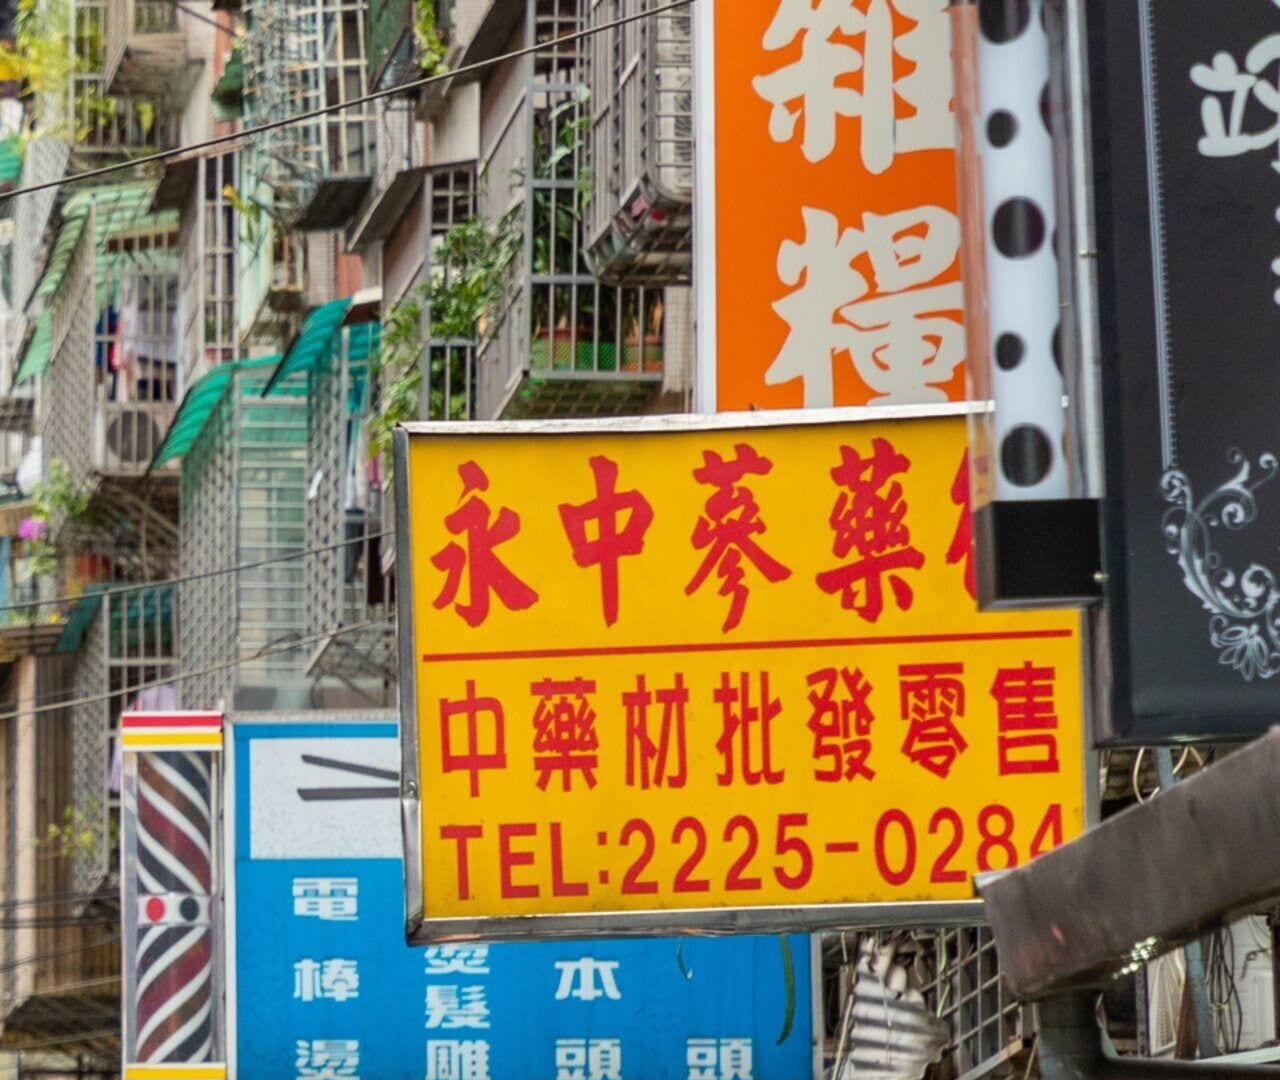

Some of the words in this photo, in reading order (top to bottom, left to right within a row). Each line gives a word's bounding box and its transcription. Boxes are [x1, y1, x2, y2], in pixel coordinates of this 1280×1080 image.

[431, 437, 980, 633] 永中蔘藥
[439, 661, 1060, 799] 中藥材批發零售
[441, 804, 1066, 902] TEL:2225-0284
